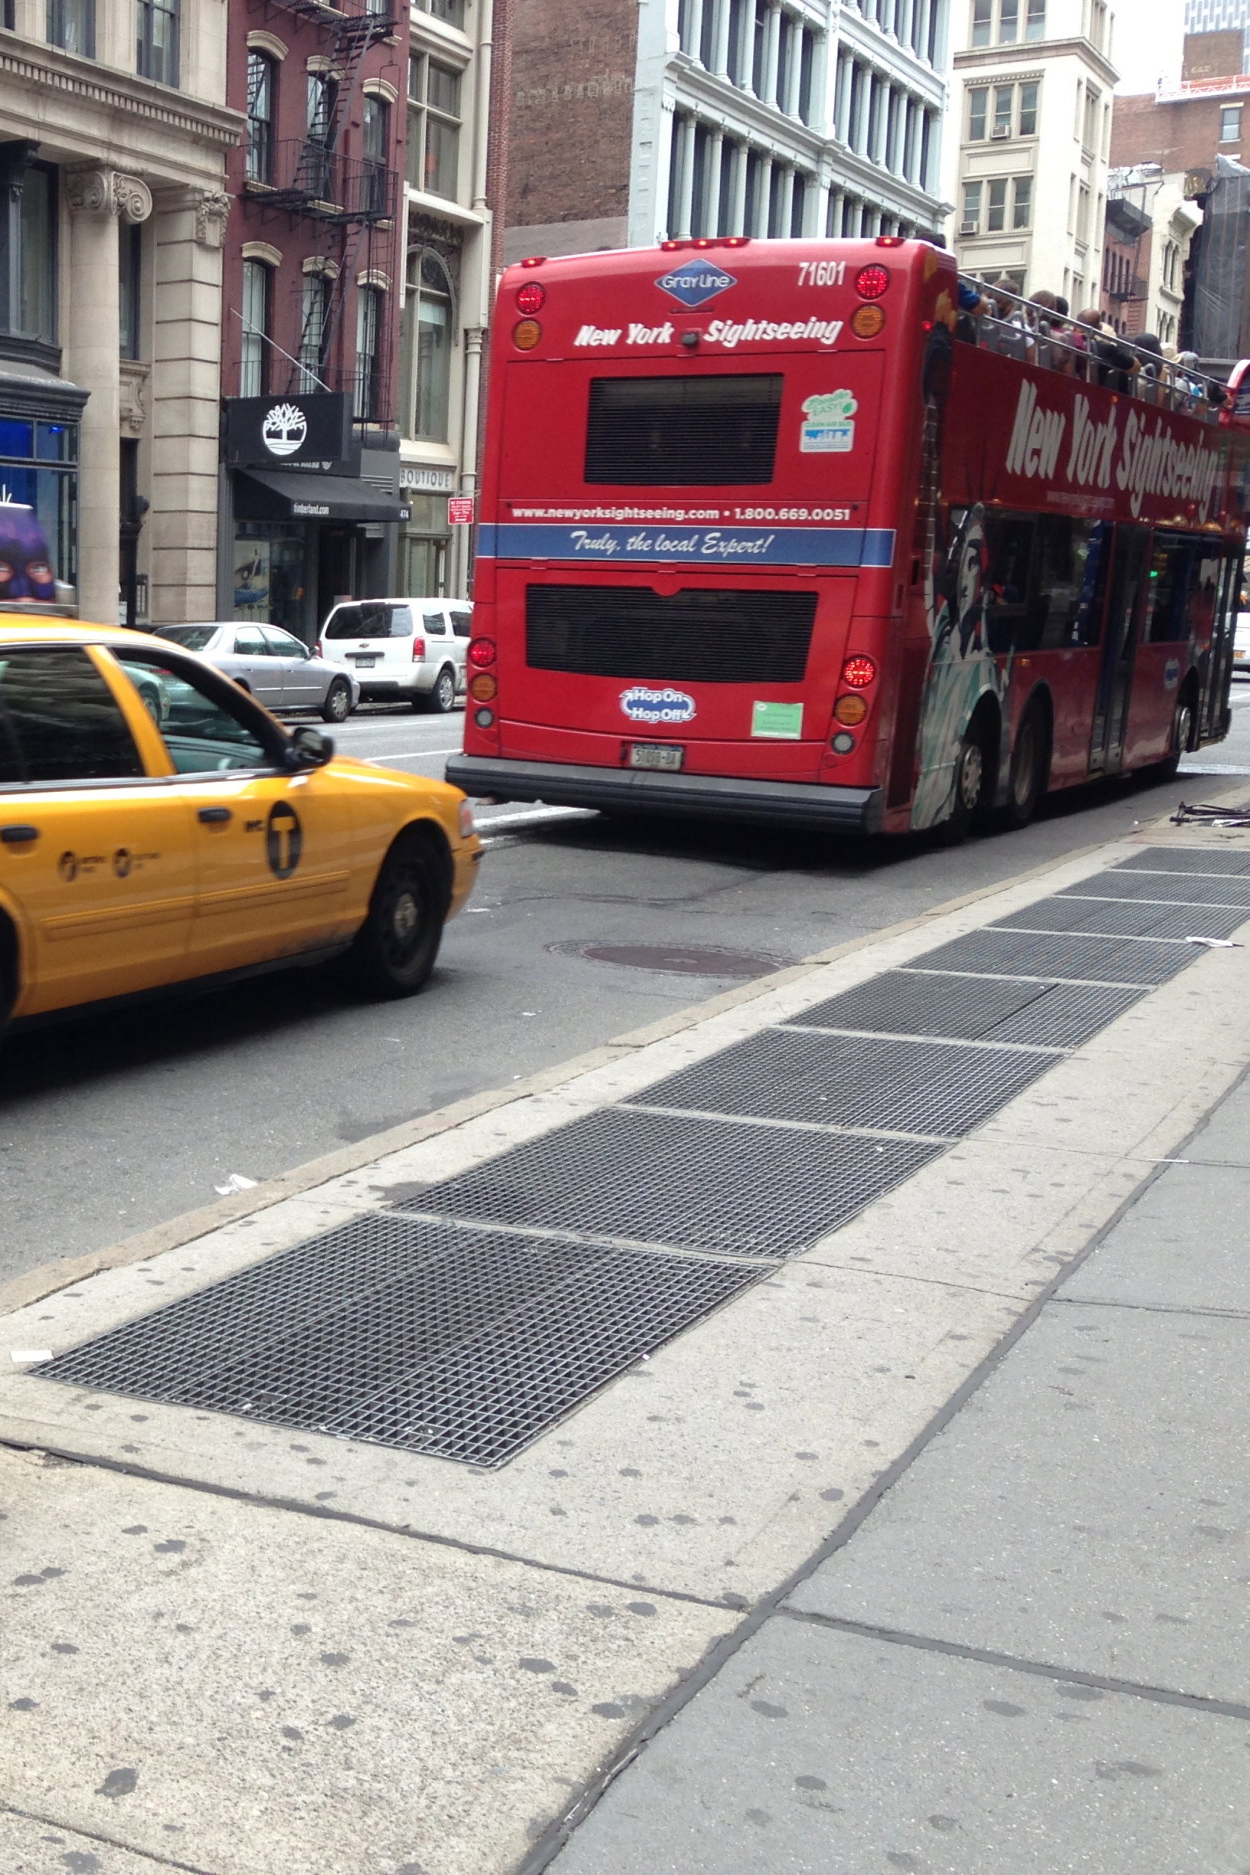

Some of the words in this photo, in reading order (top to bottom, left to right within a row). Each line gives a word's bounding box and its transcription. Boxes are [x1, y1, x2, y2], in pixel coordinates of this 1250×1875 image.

[797, 261, 846, 286] 71601
[574, 325, 622, 346] New
[626, 322, 675, 345] York
[703, 316, 844, 348] Sightseeing
[1006, 378, 1066, 480] New
[1067, 393, 1118, 489] York
[1116, 407, 1218, 525] Sightseeing
[400, 469, 450, 488] BOUTIQUE
[293, 502, 330, 515] timberland.com
[512, 506, 719, 521] www.newyorksightseeing.com
[734, 507, 850, 521] 1.800.669.0051
[626, 531, 652, 551] the
[654, 534, 699, 552] local
[701, 532, 775, 557] Expert!
[635, 689, 662, 704] Hop
[663, 690, 683, 702] On
[632, 707, 661, 722] Hop
[662, 708, 682, 720] Off
